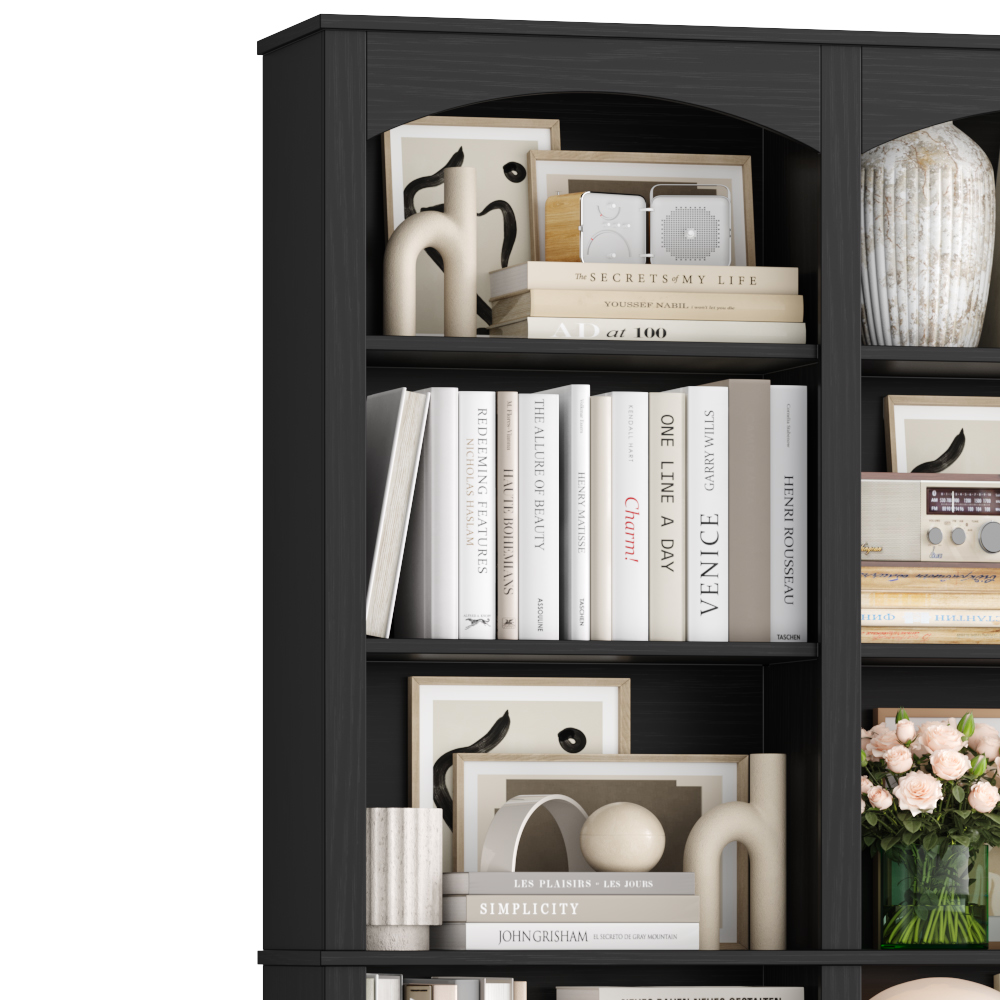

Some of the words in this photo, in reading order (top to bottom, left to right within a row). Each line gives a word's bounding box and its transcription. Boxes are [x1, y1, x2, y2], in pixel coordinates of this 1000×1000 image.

[575, 272, 587, 281] The
[590, 273, 668, 283] SECRETS
[671, 274, 679, 283] of
[682, 275, 706, 284] MY
[718, 276, 758, 286] LIFE
[552, 322, 600, 338] AD
[606, 328, 626, 338] at
[635, 327, 667, 339] 100
[534, 399, 544, 424] THE
[660, 414, 674, 446] ONE
[704, 410, 714, 447] WILLS
[478, 408, 487, 494] REDEEMING
[534, 427, 544, 476] ALLURE
[704, 450, 714, 491] GARRY
[504, 470, 514, 514] HAUTE
[534, 480, 544, 496] OF
[660, 462, 674, 503] LINE
[784, 476, 794, 521] HENRI
[478, 502, 487, 574] FEATURES
[534, 500, 544, 550] BEAUTY
[624, 497, 640, 562] Charm!
[660, 516, 674, 527] A
[504, 518, 514, 594] BOHEMIANS
[660, 540, 674, 572] DAY
[700, 514, 720, 616] VENICE
[784, 527, 794, 604] ROUSSEAU
[480, 902, 579, 915] SIMPLICITY
